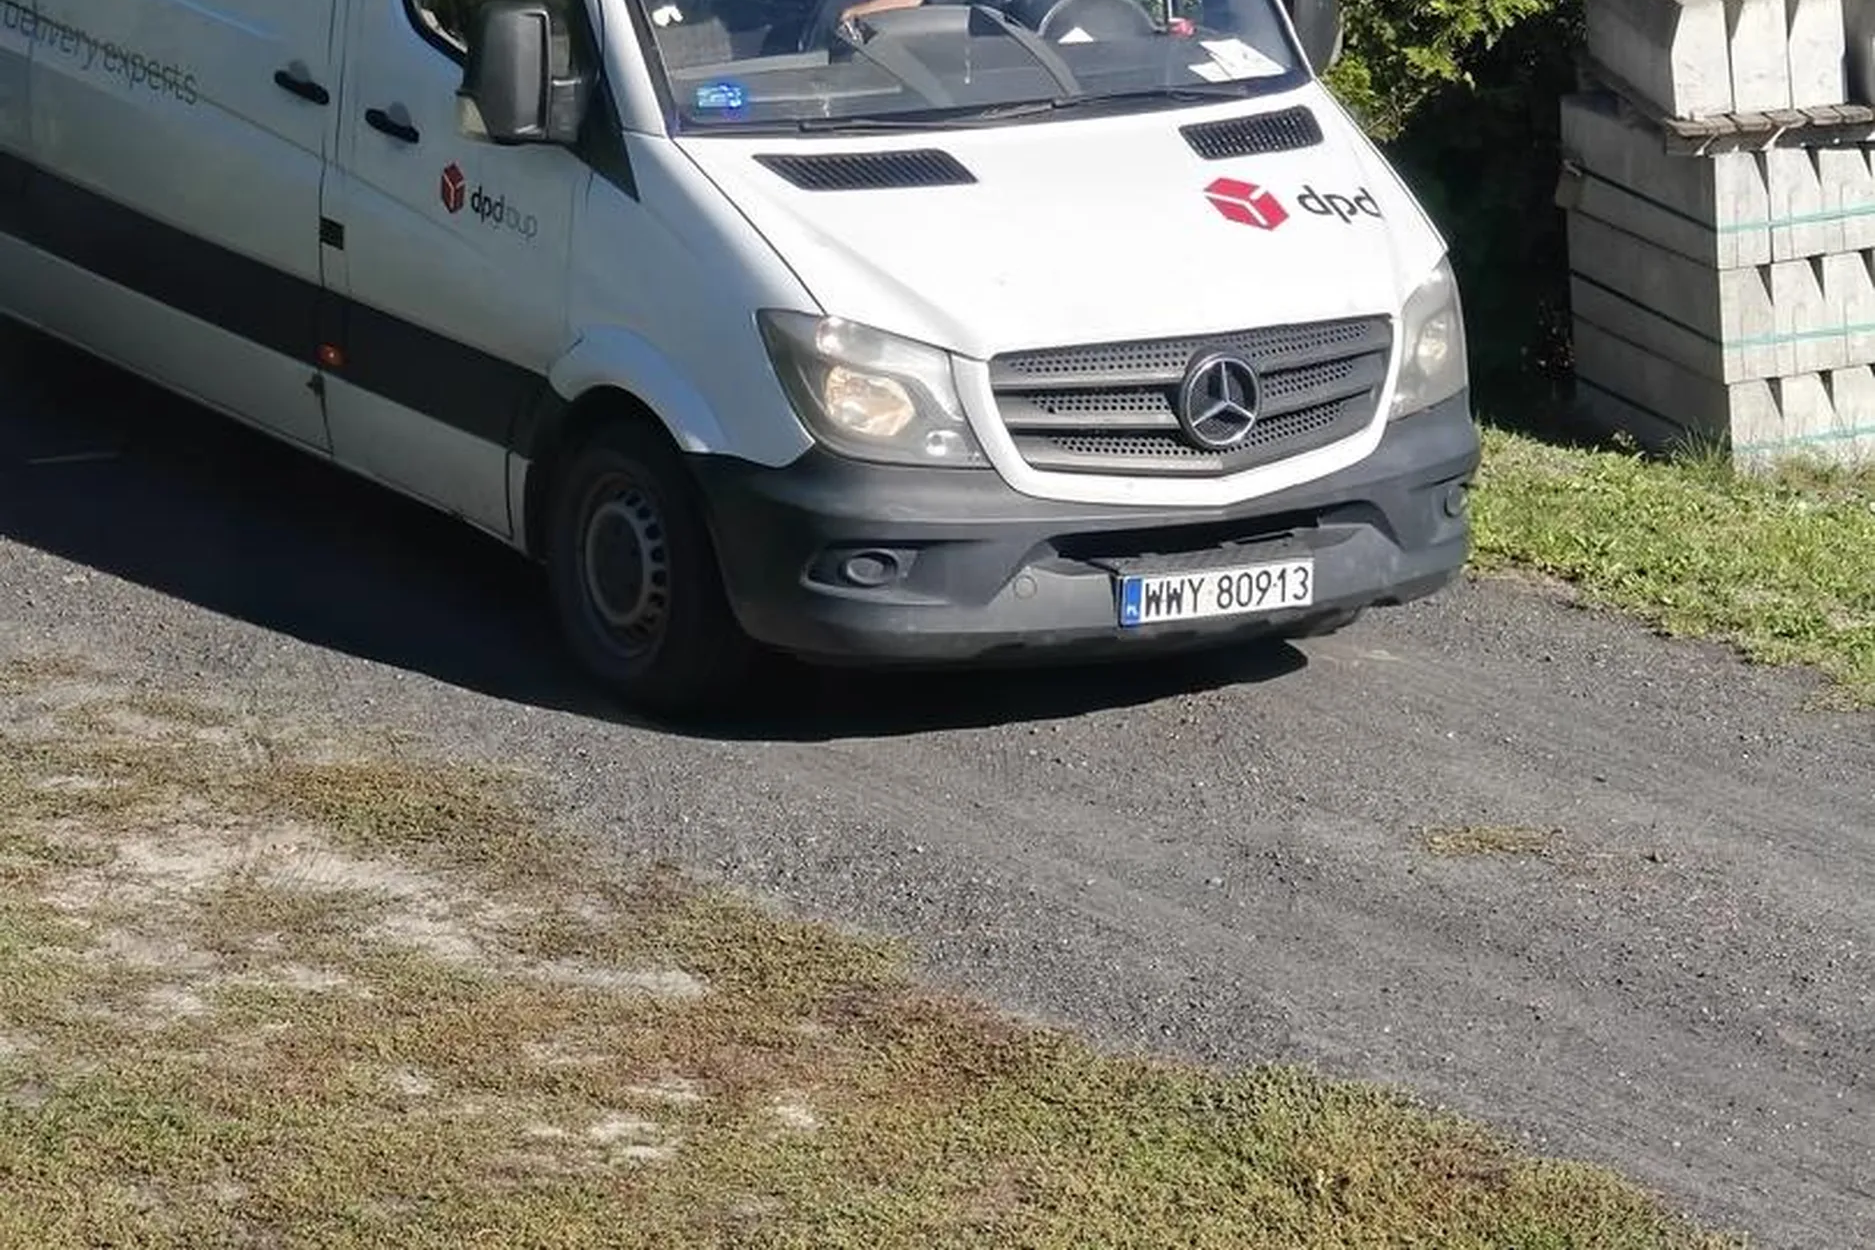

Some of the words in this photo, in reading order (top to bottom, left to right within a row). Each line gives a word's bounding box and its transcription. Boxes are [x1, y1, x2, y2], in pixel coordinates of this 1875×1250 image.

[103, 41, 198, 106] experts
[1297, 184, 1384, 225] dpd
[1144, 577, 1205, 618] WWY
[1216, 566, 1310, 610] 80913
